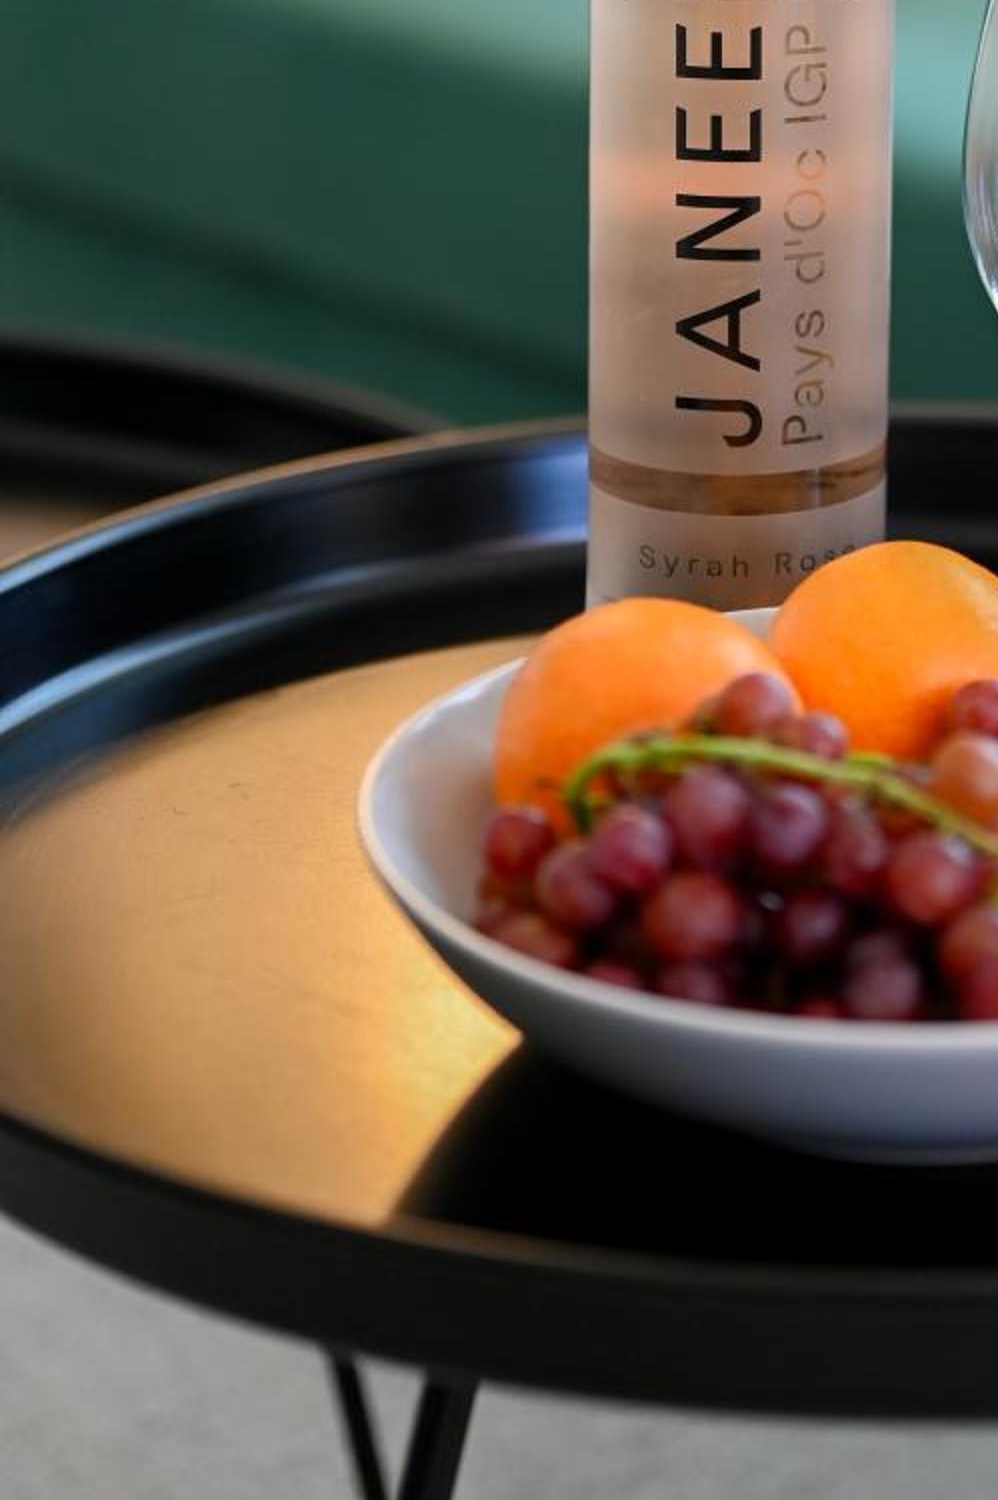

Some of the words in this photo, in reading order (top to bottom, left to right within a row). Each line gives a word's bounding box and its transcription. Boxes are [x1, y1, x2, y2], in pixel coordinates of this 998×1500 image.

[784, 24, 827, 124] IGP
[675, 23, 763, 448] JANEE
[784, 149, 827, 284] d'Oc
[782, 310, 834, 446] Pays
[639, 544, 749, 578] Syrah
